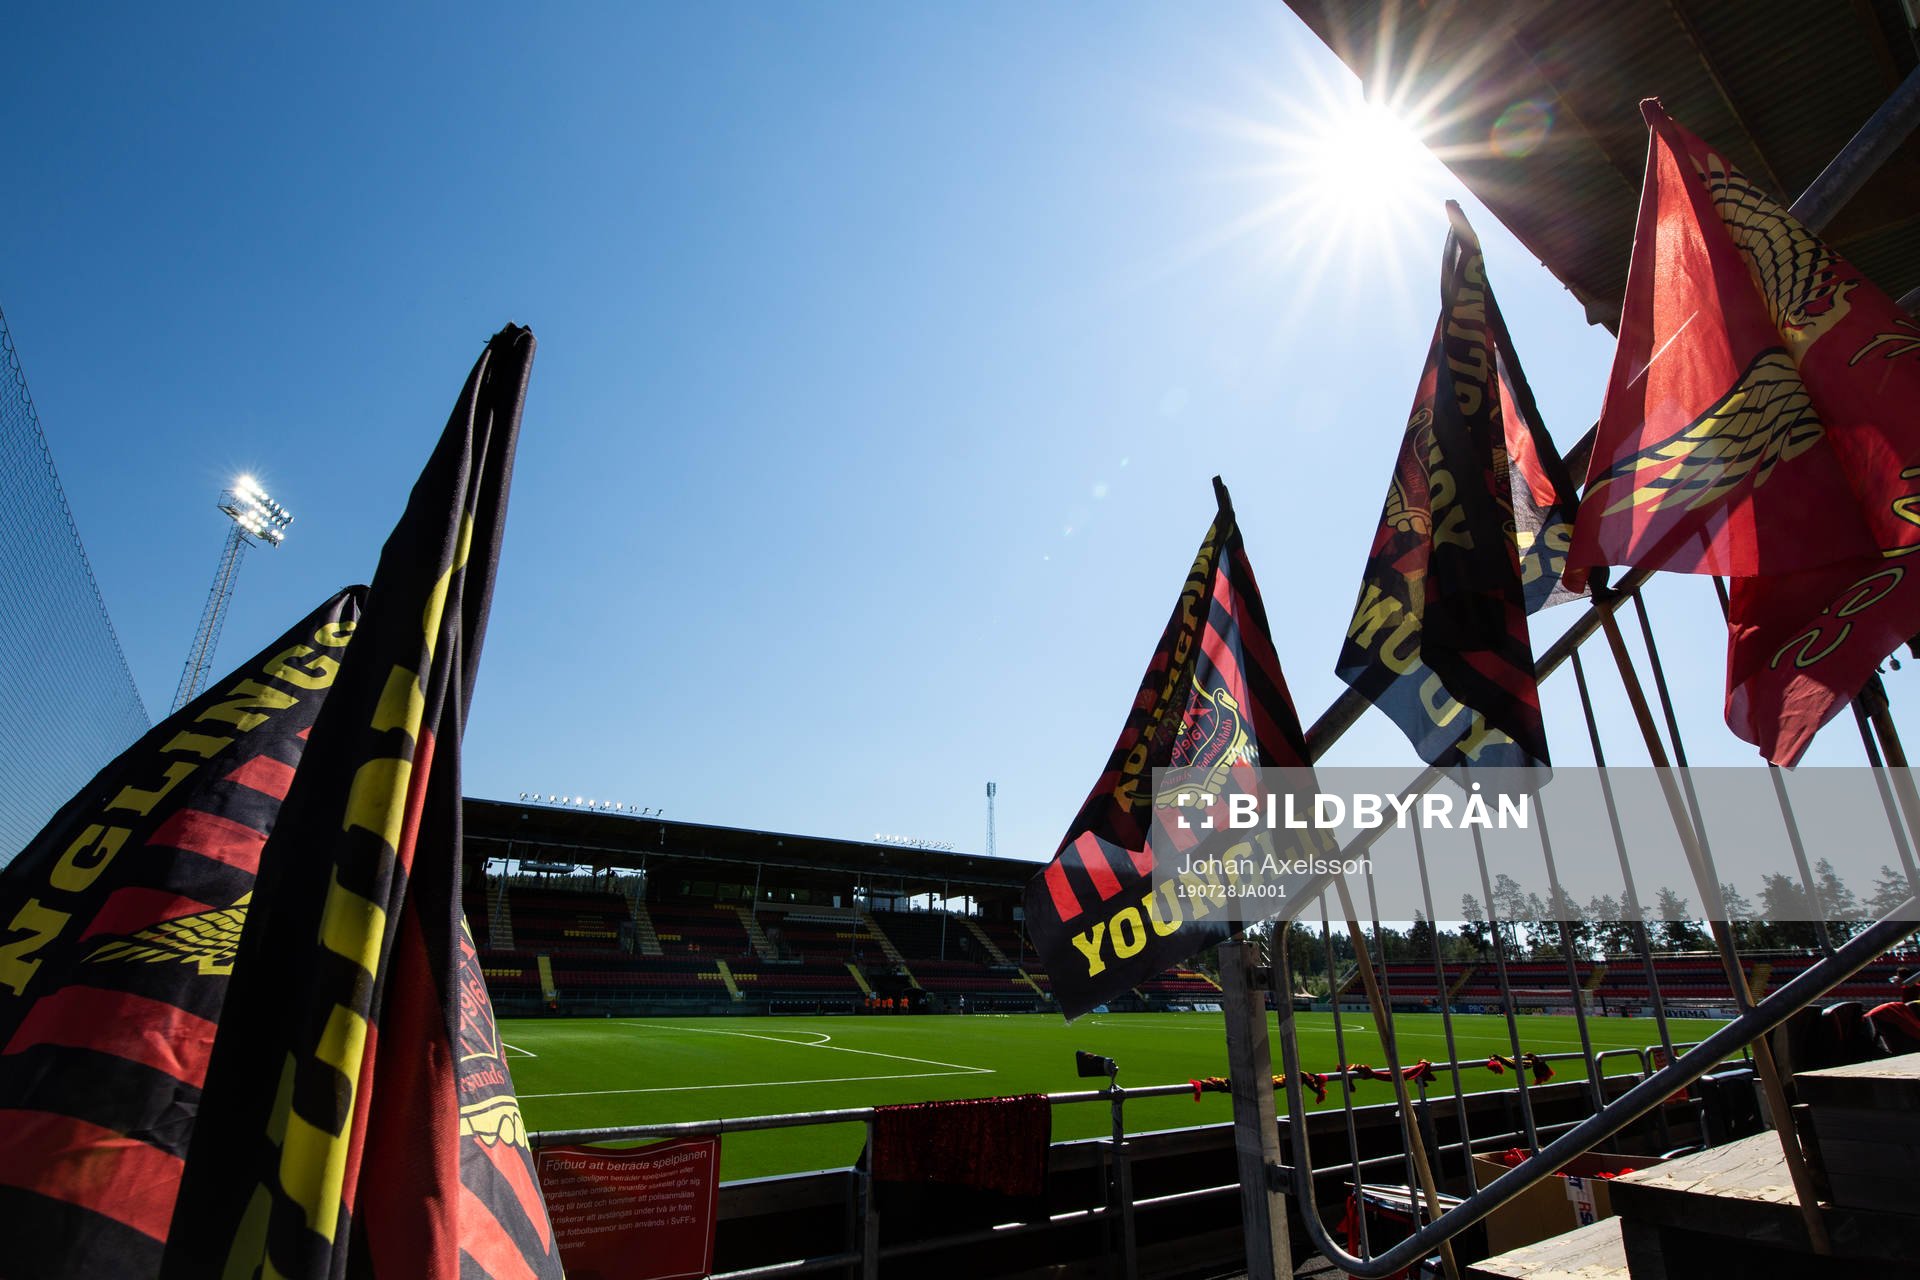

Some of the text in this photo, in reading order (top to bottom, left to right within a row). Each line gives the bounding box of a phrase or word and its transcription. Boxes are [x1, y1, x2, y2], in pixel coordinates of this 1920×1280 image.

[545, 1149, 707, 1172] Förbud att beträda spelplanen
